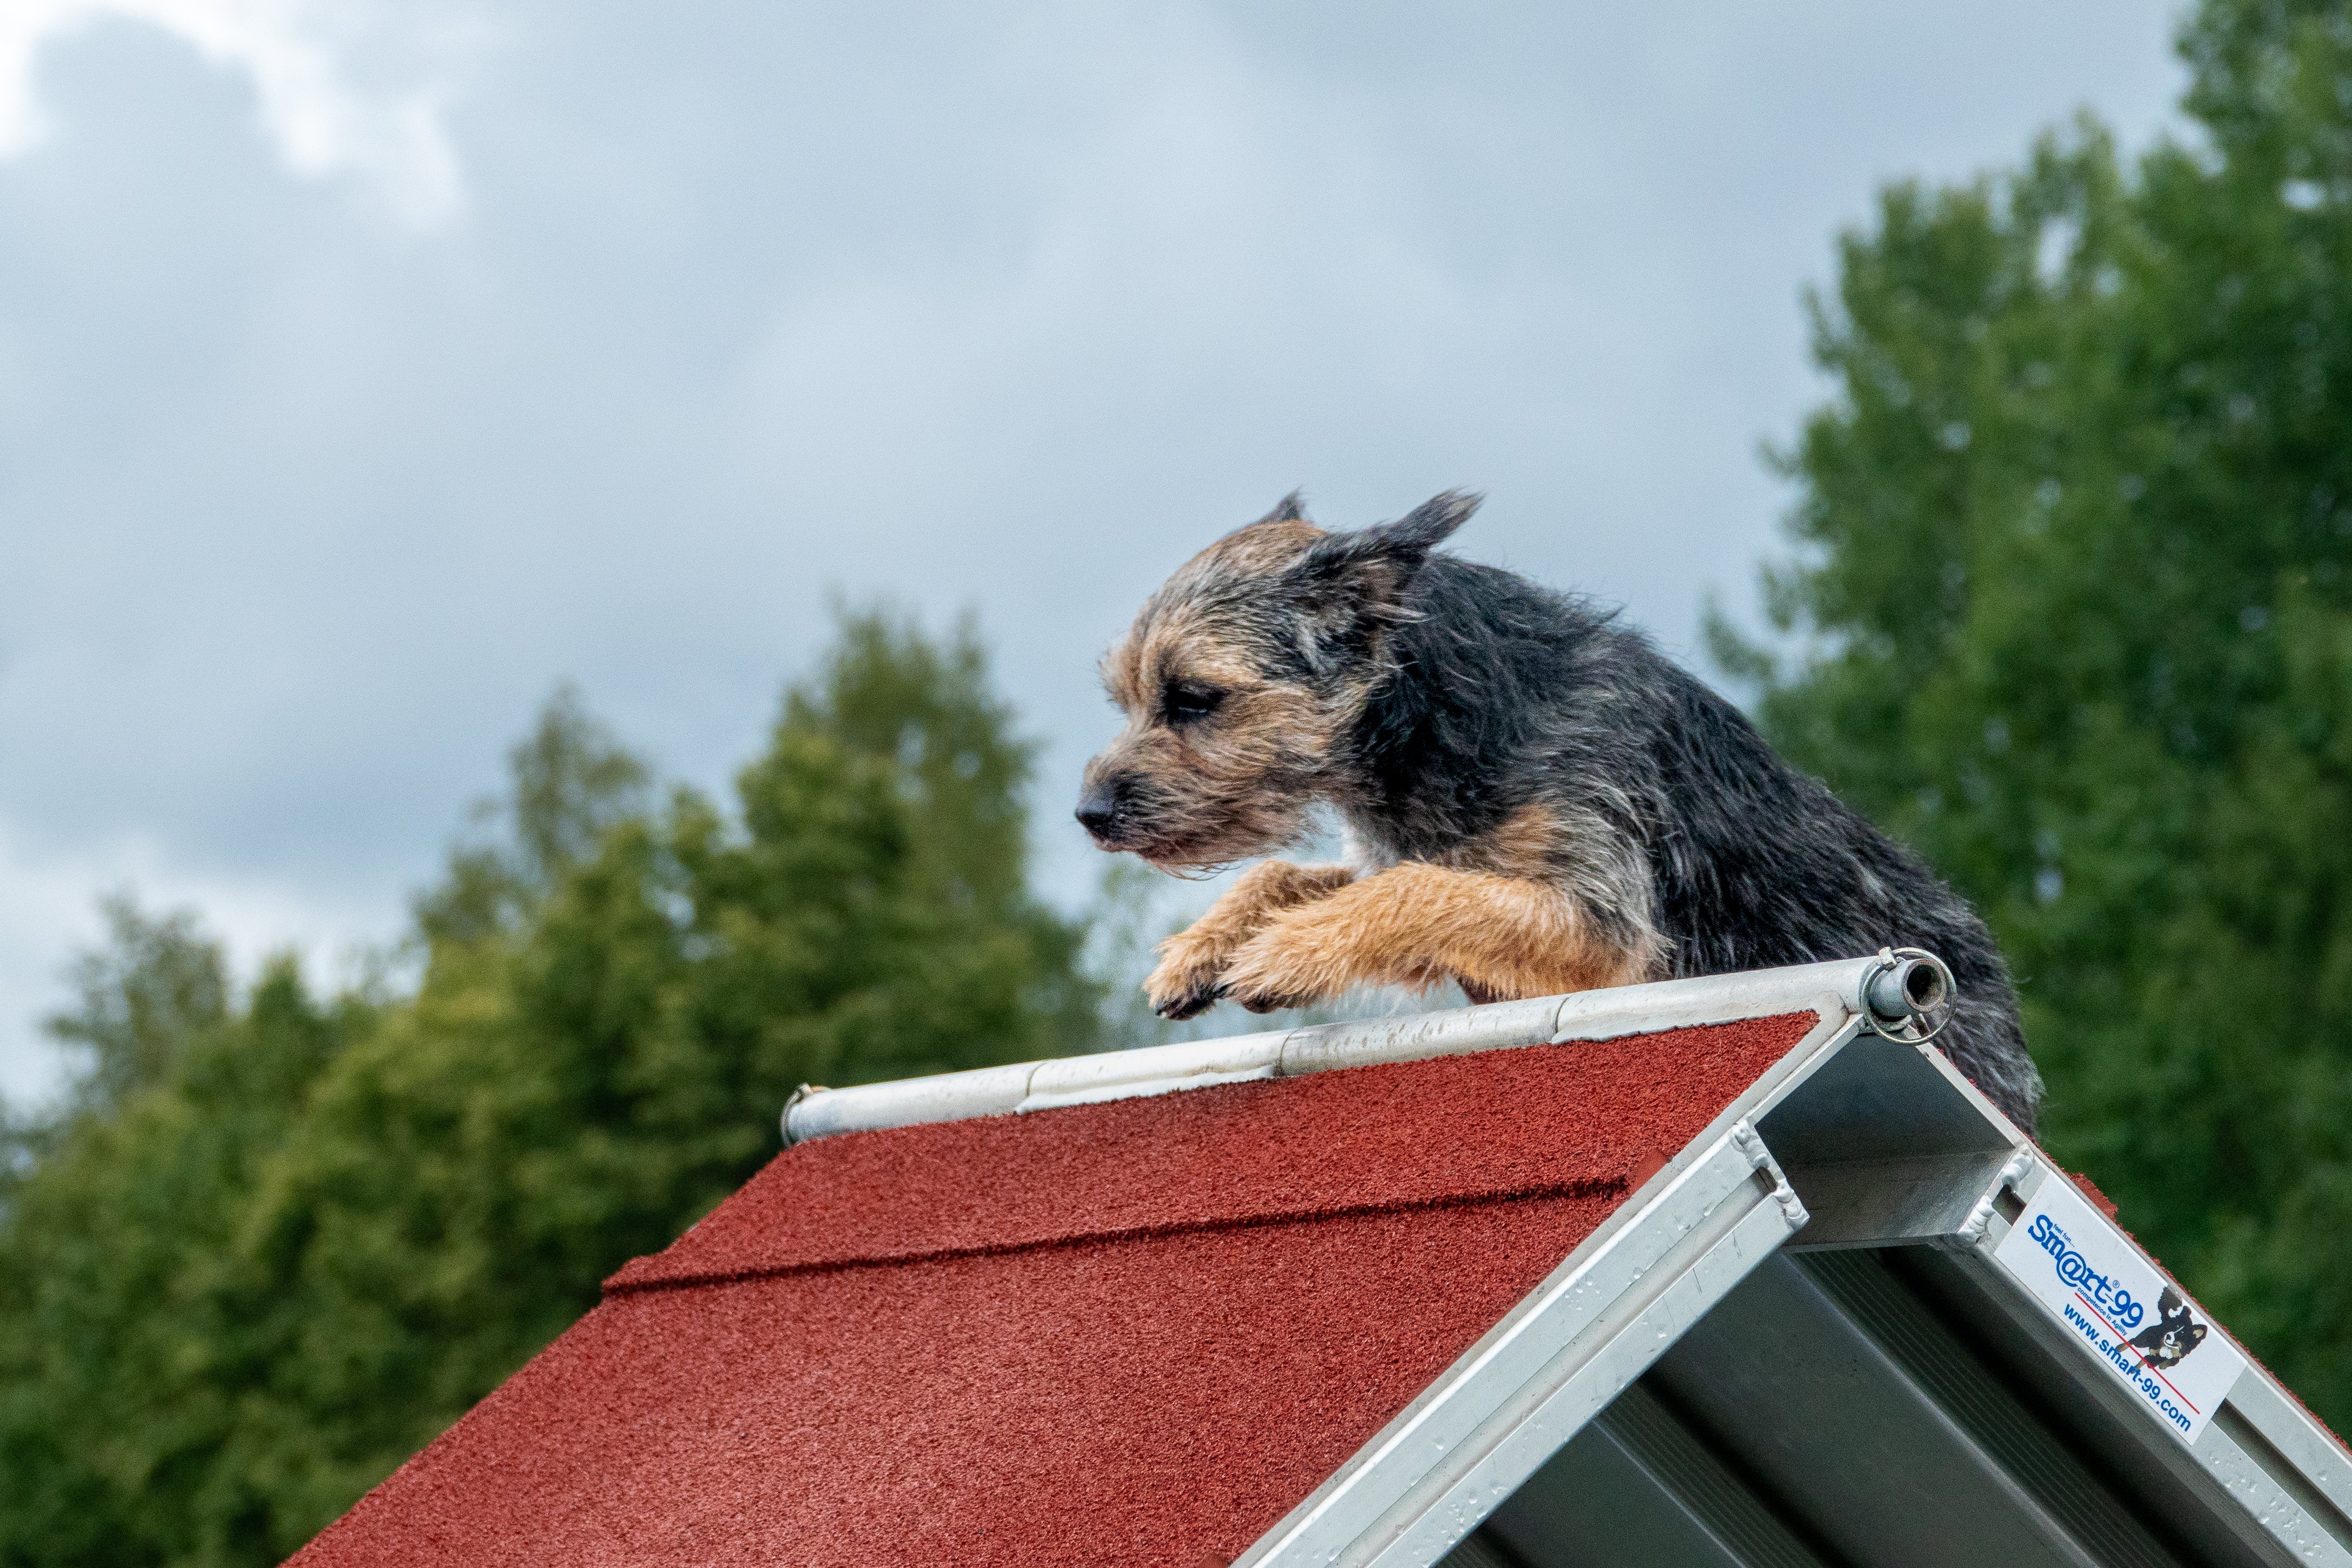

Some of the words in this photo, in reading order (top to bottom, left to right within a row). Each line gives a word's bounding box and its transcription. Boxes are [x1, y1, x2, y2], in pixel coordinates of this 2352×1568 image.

[2053, 1223, 2063, 1235] feel
[2077, 1287, 2107, 1316] competence
[2111, 1319, 2128, 1336] Agility
[2063, 1303, 2192, 1432] www.smart-99.com
